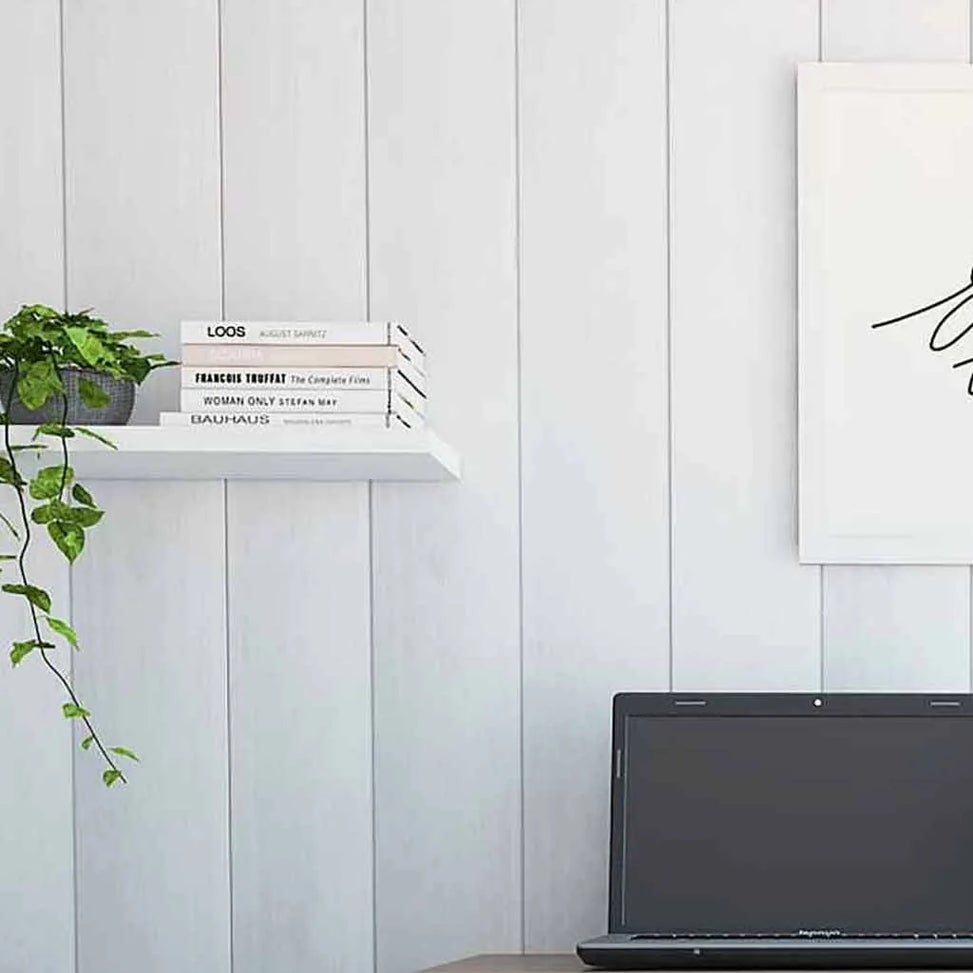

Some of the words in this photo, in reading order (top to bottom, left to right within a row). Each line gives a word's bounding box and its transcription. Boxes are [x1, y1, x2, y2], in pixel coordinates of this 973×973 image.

[207, 325, 246, 338] LOOS
[195, 372, 243, 385] FRANCOIS
[290, 374, 305, 386] The
[307, 374, 346, 387] Complete
[203, 396, 245, 407] WOMAN
[247, 396, 274, 408] ONLY
[191, 413, 270, 425] BAUHAUS
